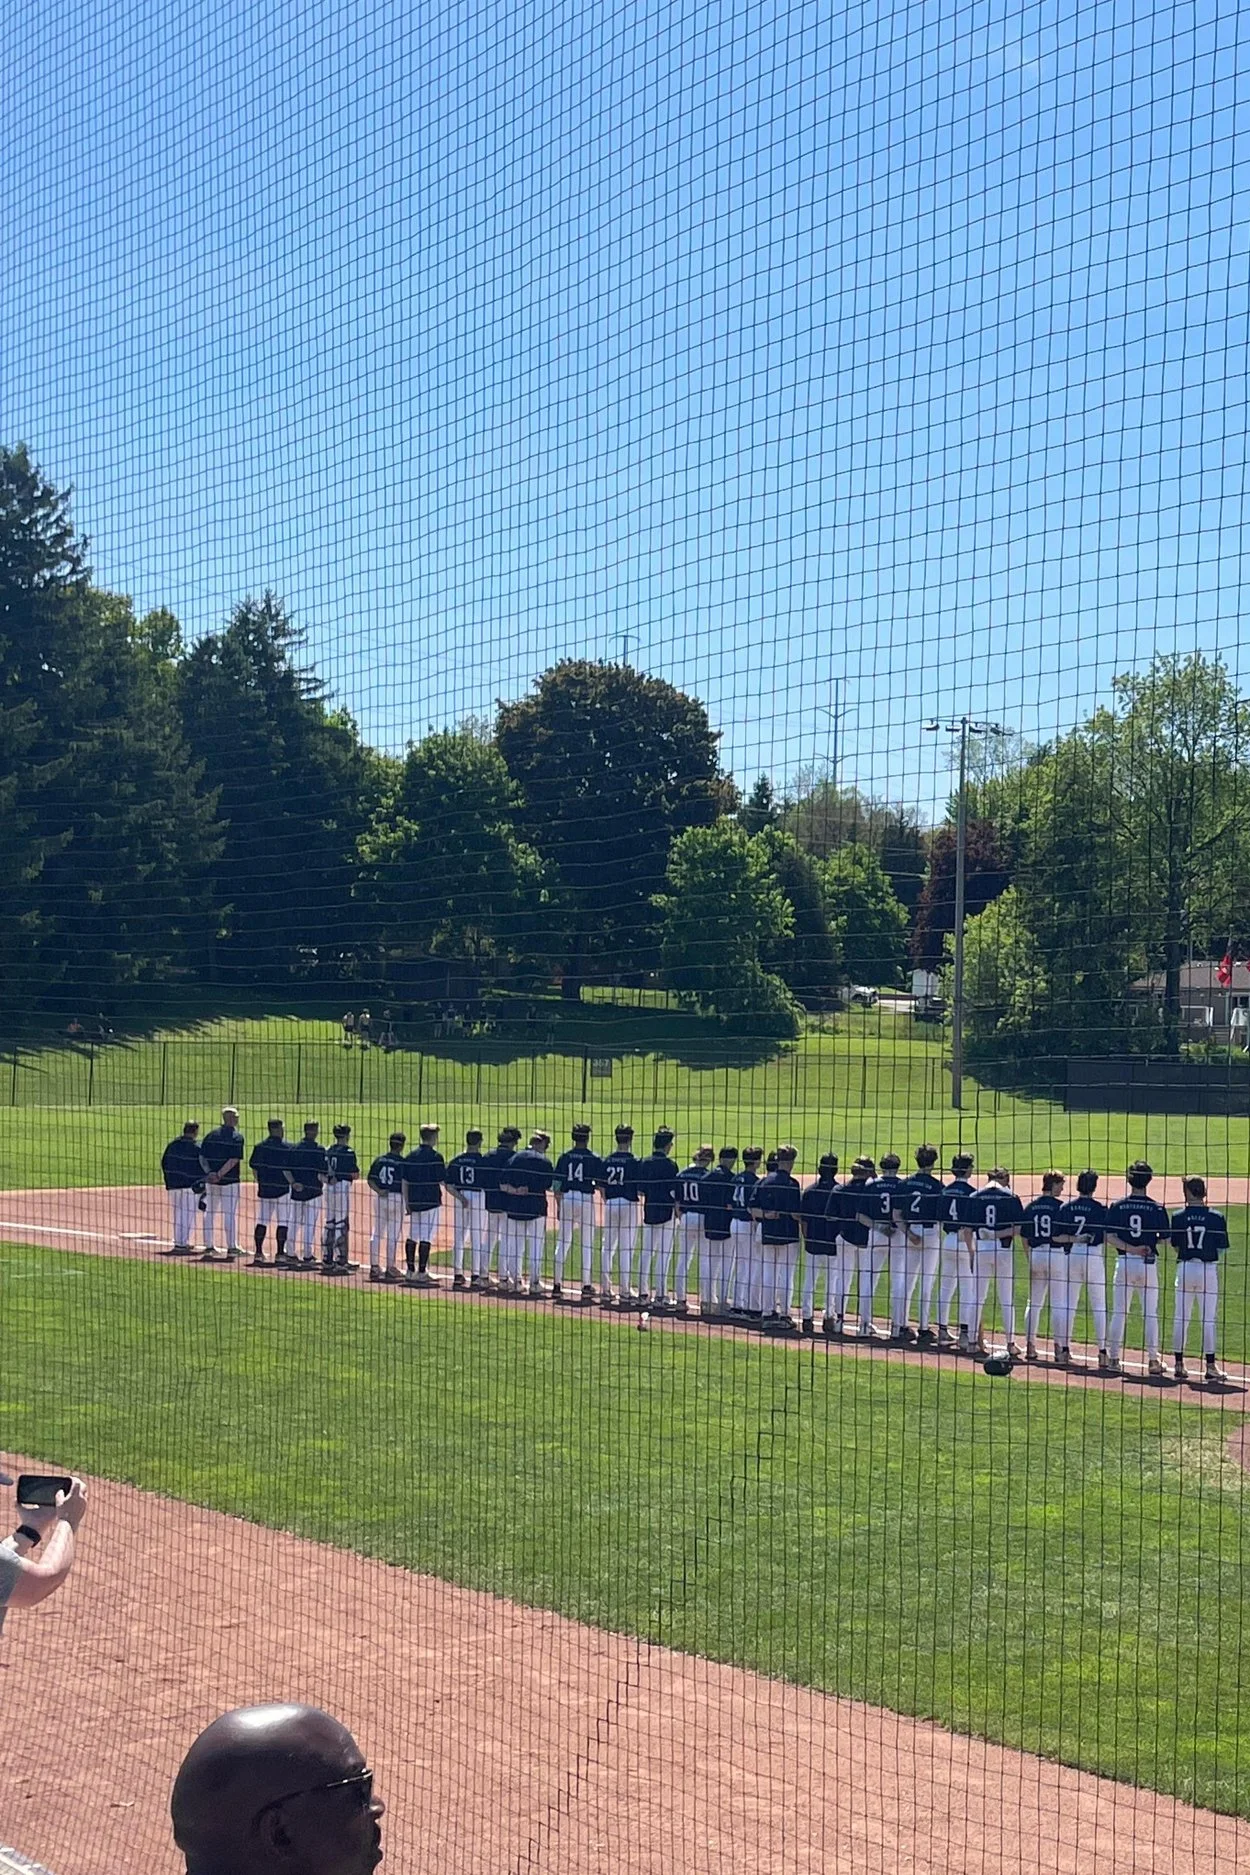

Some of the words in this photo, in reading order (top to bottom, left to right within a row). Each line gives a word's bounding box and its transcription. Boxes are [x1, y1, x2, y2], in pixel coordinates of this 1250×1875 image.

[379, 1166, 395, 1185] 45
[459, 1166, 475, 1184] 13
[567, 1162, 584, 1182] 14
[606, 1166, 625, 1185] 27
[682, 1182, 699, 1201] 10
[880, 1192, 890, 1214] 3
[911, 1191, 922, 1213] 2
[949, 1199, 958, 1220] 4
[1034, 1214, 1051, 1237] 19
[1074, 1216, 1086, 1236] 7
[1129, 1215, 1142, 1238] 9
[1186, 1226, 1206, 1249] 17
